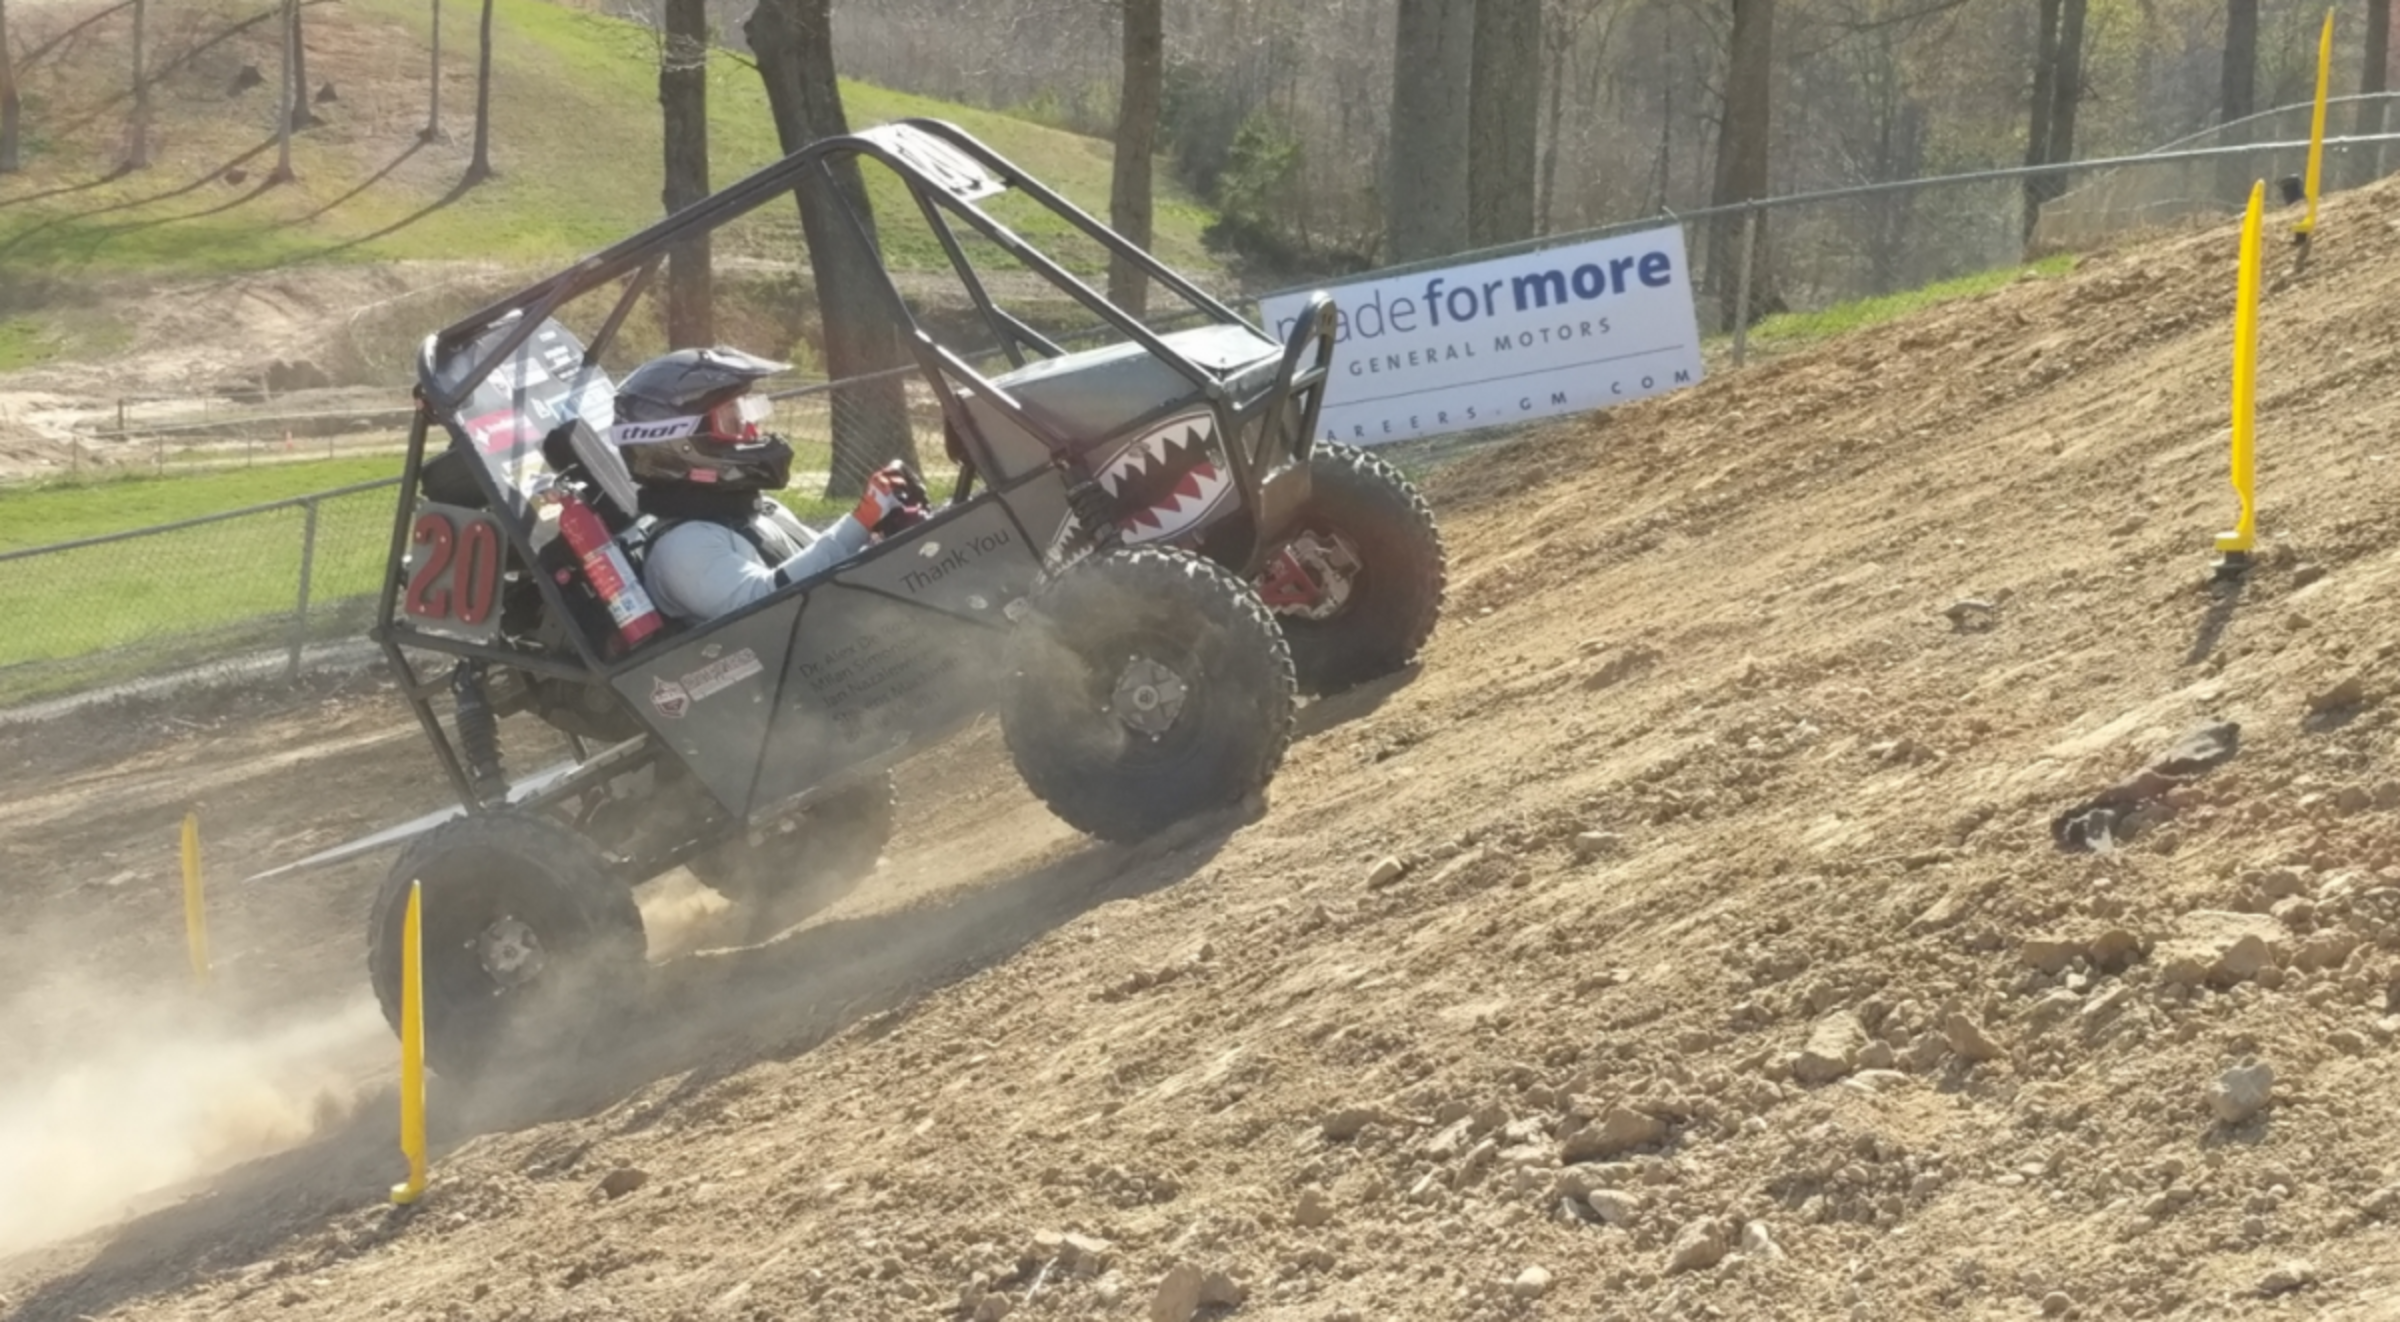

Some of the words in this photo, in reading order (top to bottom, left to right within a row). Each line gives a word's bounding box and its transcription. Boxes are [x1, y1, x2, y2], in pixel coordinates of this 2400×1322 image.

[1422, 277, 1505, 327] for
[1510, 249, 1672, 312] more
[1348, 341, 1476, 376] GENERAL
[1493, 316, 1612, 353] MOTORS
[621, 421, 689, 441] thor
[405, 513, 497, 625] 20
[899, 552, 969, 594] Thank
[966, 527, 1011, 559] You
